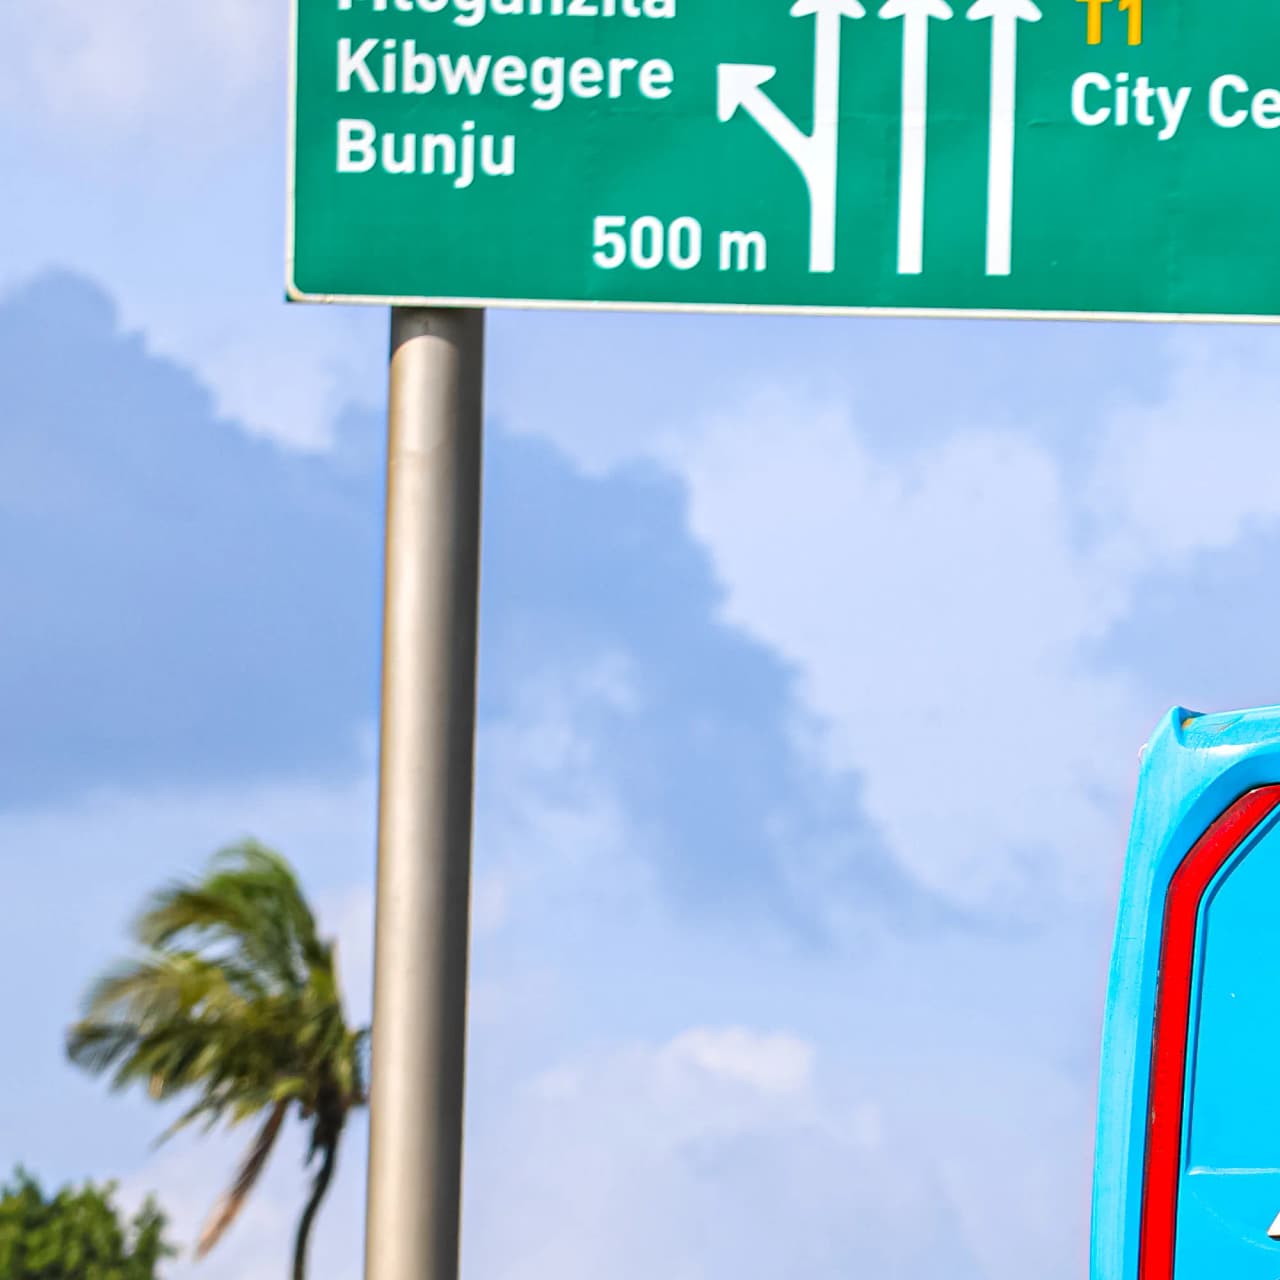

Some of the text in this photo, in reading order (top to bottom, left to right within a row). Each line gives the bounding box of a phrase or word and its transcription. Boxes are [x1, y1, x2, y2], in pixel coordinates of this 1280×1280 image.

[1076, 0, 1142, 46] T1
[336, 37, 675, 111] Kibwegere
[1071, 71, 1192, 141] City
[336, 118, 516, 189] Bunju
[592, 215, 767, 272] 500 m
